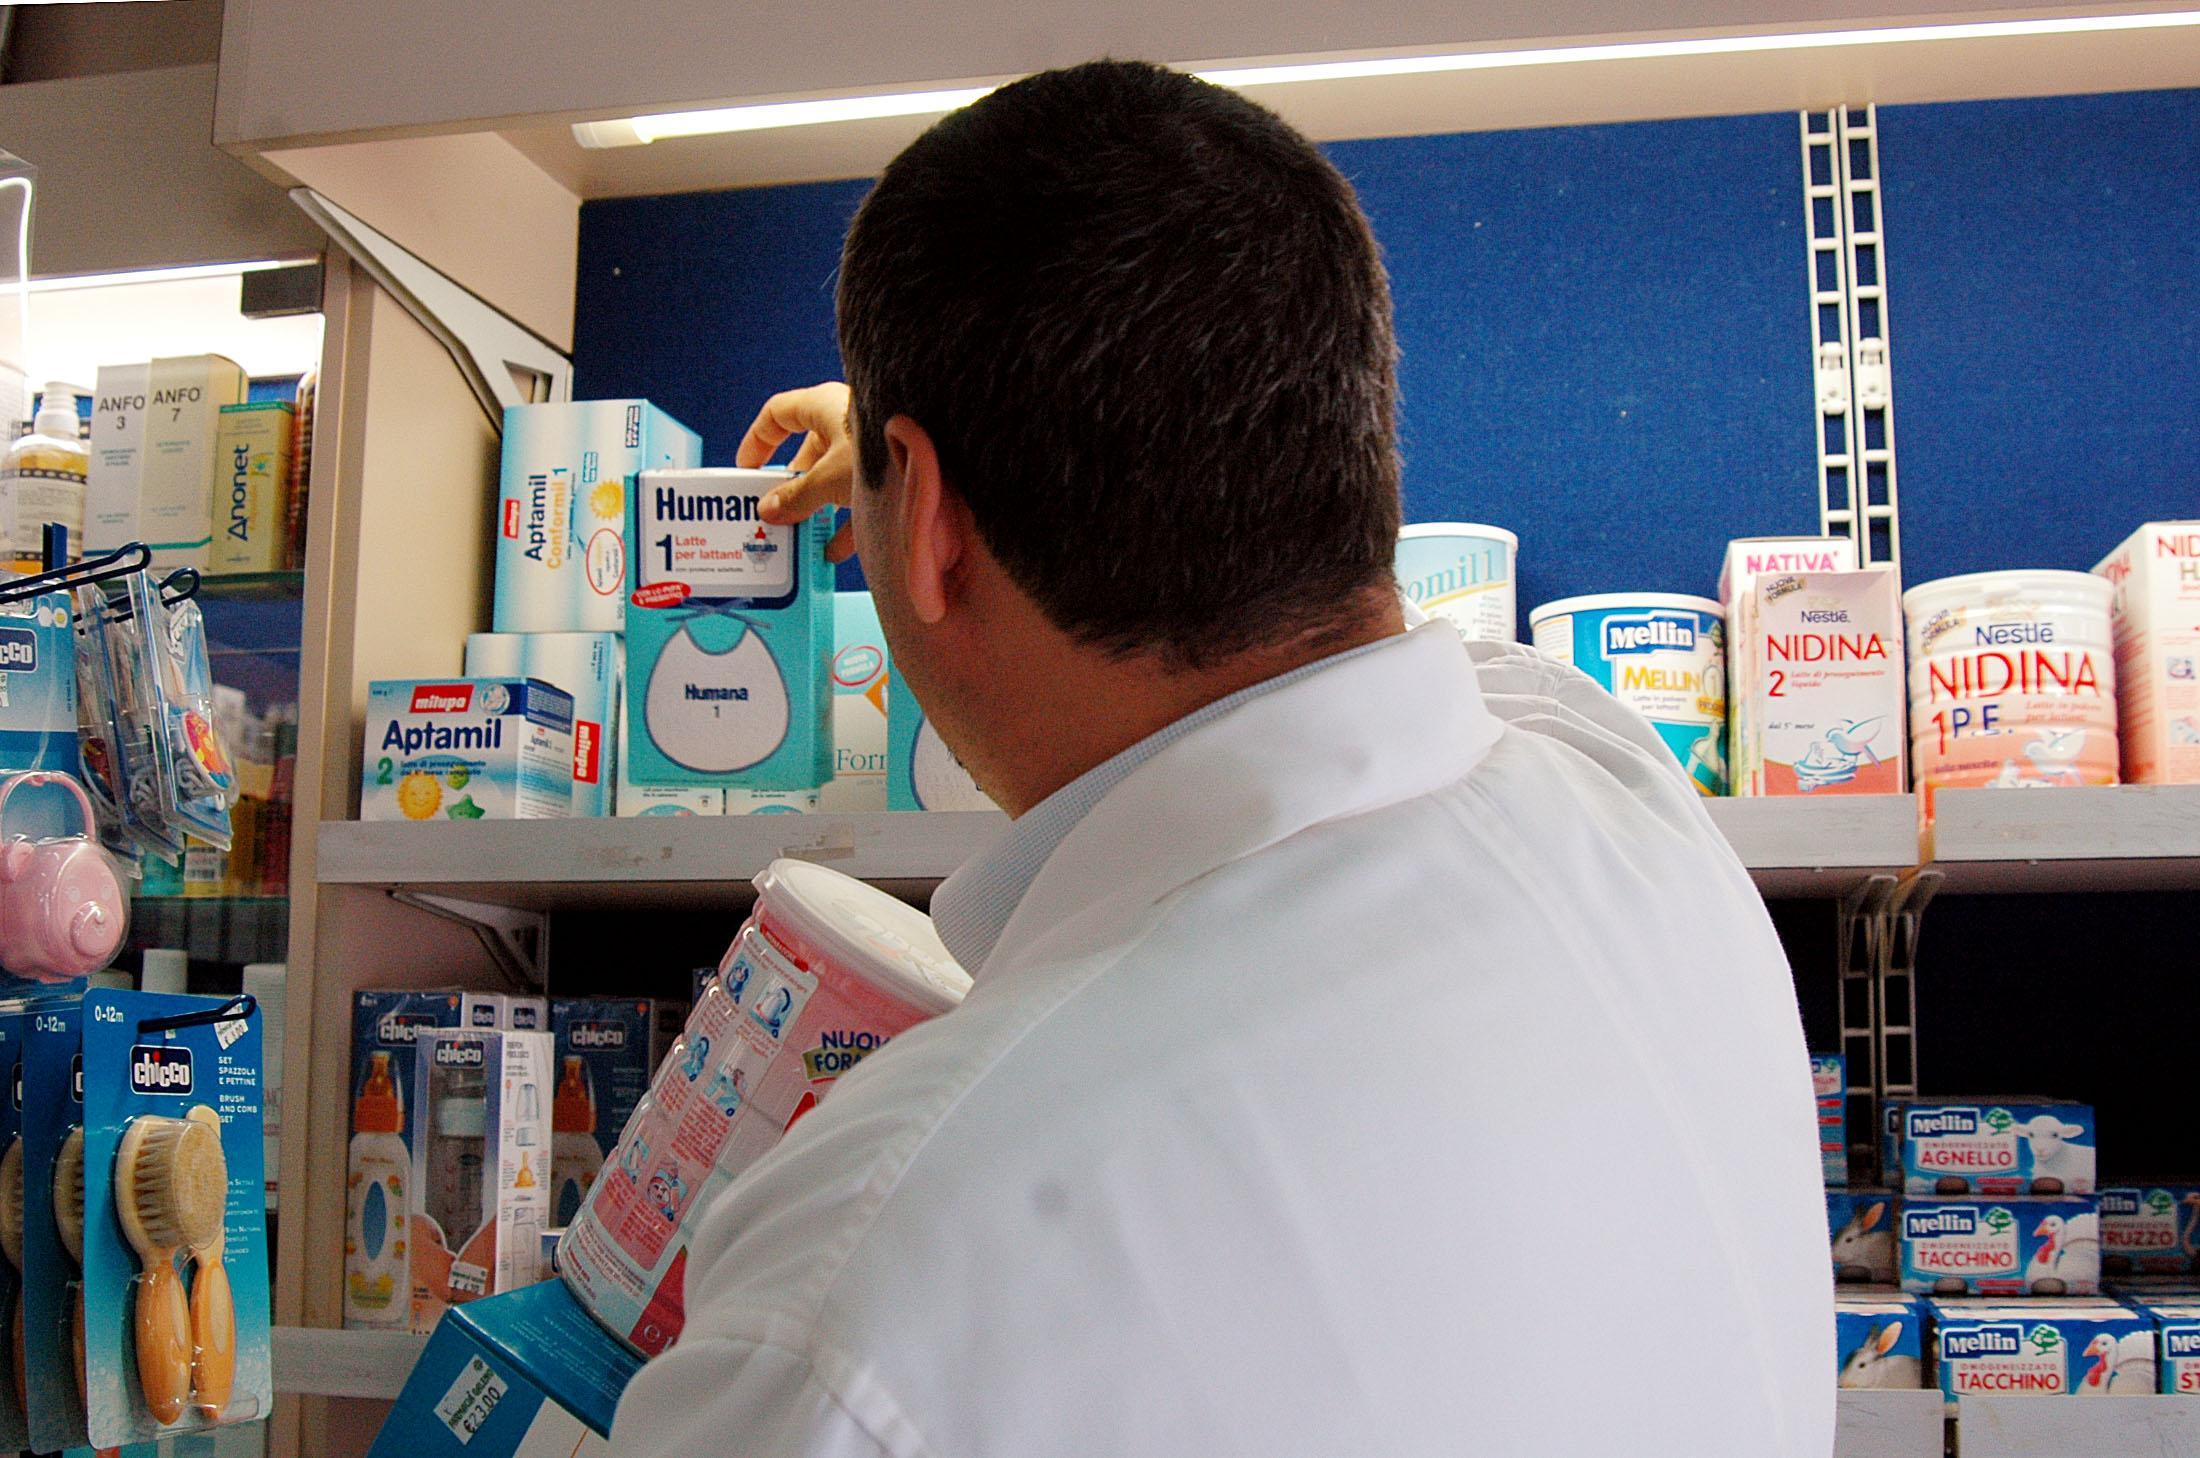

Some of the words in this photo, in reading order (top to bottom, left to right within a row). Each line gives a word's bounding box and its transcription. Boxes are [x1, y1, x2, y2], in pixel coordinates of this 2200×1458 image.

[98, 395, 145, 412] ANFO
[152, 387, 201, 405] ANFO
[116, 417, 126, 430] 3
[172, 408, 181, 421] 7
[228, 444, 249, 541] Anonet
[656, 487, 761, 521] Human
[525, 474, 547, 561] Aptamil
[546, 481, 566, 570] Conformil
[675, 536, 707, 547] Latte
[656, 534, 672, 571] 1
[675, 550, 696, 561] per
[700, 548, 743, 560] lattanti
[1747, 554, 1834, 574] NATIVA
[1407, 553, 1478, 604] omil
[1610, 621, 1693, 650] Mellin
[1767, 633, 1887, 662] NIDINA
[1624, 665, 1700, 691] MELLIN
[1768, 670, 1786, 697] 2
[1929, 650, 2101, 704] NIDINA
[684, 683, 749, 701] Humana
[415, 694, 467, 712] milupa
[712, 706, 721, 718] 1
[382, 718, 502, 756] Aptamil
[1932, 710, 1945, 756] 1
[576, 725, 591, 778] milupa
[377, 756, 393, 785] 2
[95, 1005, 124, 1022] 0-12m
[36, 1016, 66, 1033] 0-12m
[572, 1024, 623, 1046] chicco
[822, 1030, 891, 1050] NUOV
[218, 1056, 233, 1064] SET
[437, 1041, 482, 1064] chicco
[134, 1051, 190, 1087] chicco
[218, 1066, 256, 1076] SPAZZOLA
[218, 1077, 224, 1085] E
[226, 1077, 256, 1086] PETTINE
[219, 1094, 245, 1103] BRUSH
[219, 1105, 236, 1113] AND
[237, 1105, 258, 1114] COMB
[1913, 1114, 1974, 1134] Mellin
[1920, 1151, 2013, 1167] AGNELLO
[2102, 1196, 2136, 1211] llin
[1910, 1213, 1973, 1234] Mellin
[2104, 1231, 2175, 1247] RUZZO
[1918, 1251, 2013, 1267] TACCHINO
[1948, 1333, 2017, 1354] Mellin
[1957, 1373, 2061, 1390] TACCHINO
